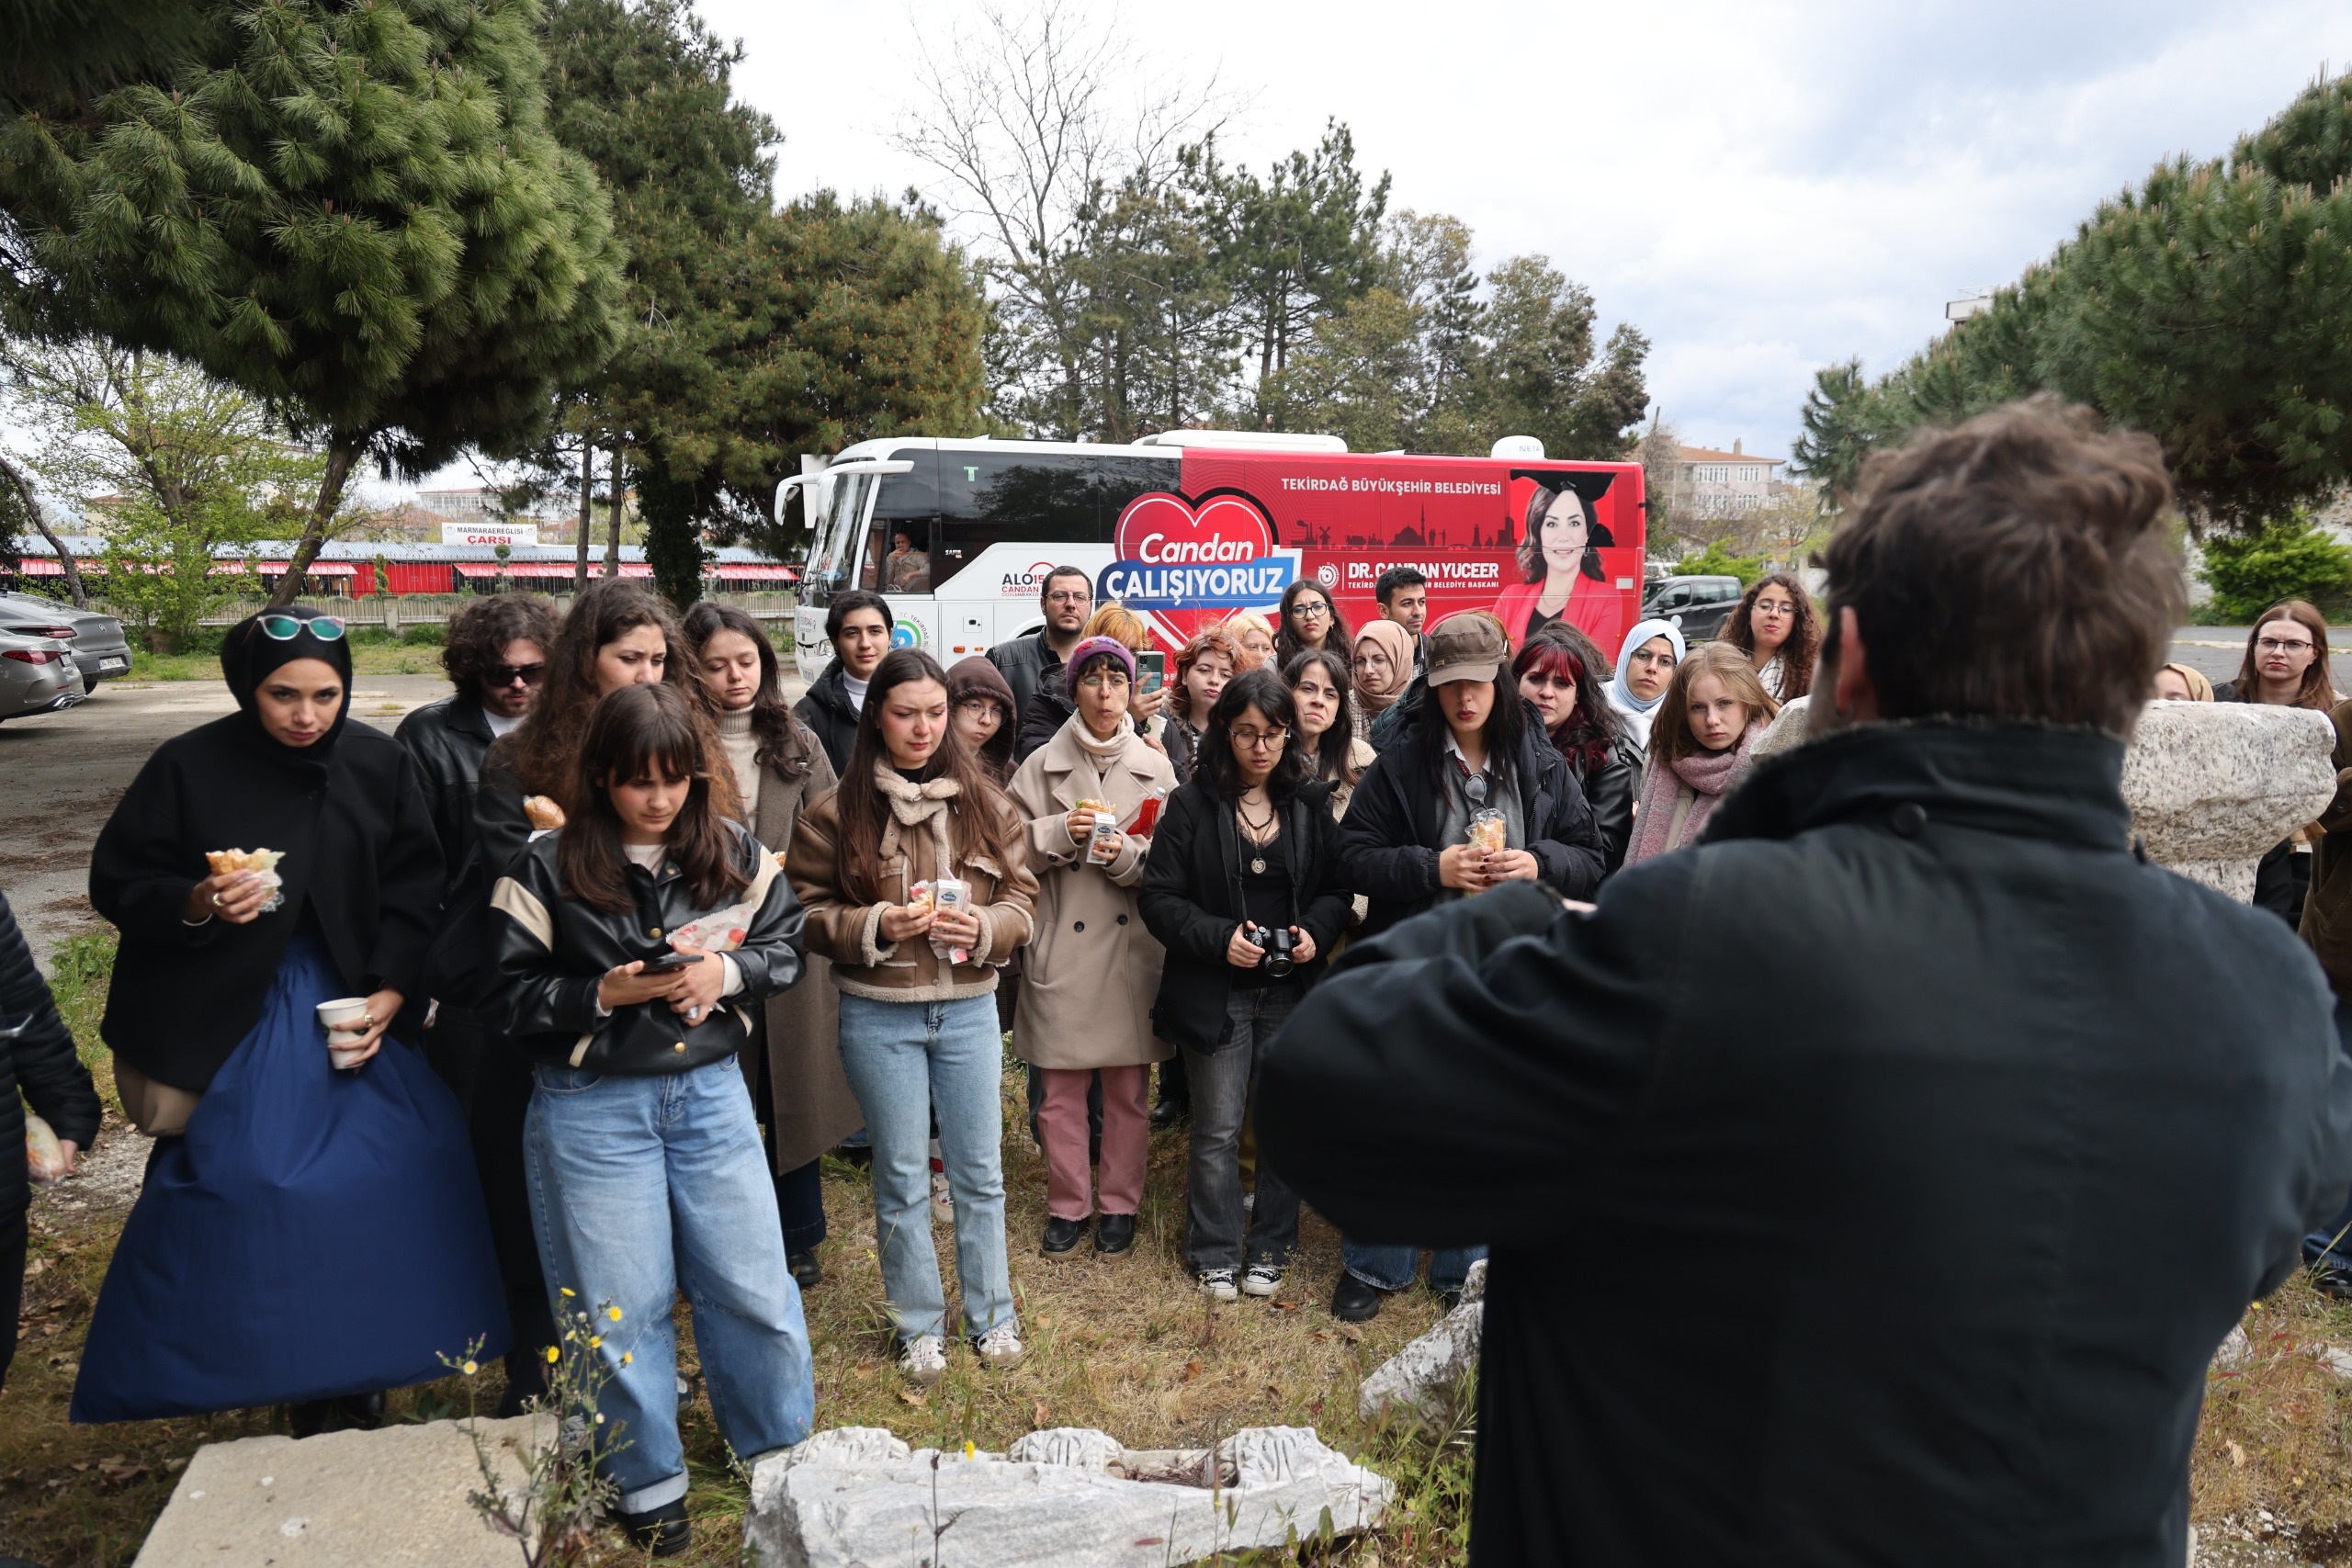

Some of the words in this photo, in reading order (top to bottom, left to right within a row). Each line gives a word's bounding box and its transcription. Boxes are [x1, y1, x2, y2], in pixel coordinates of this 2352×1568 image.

[1282, 476, 1349, 491] TEKİRDAĞ
[1351, 479, 1431, 496] BÜYÜKŞEHİR
[1434, 480, 1501, 495] BELEDİYESİ
[1139, 532, 1254, 564] Candan
[1348, 562, 1374, 579] DR.
[1106, 567, 1283, 606] ÇALIŞIYORUZ
[1433, 581, 1466, 589] BELEDİYE
[1467, 581, 1499, 590] BAŞKANI
